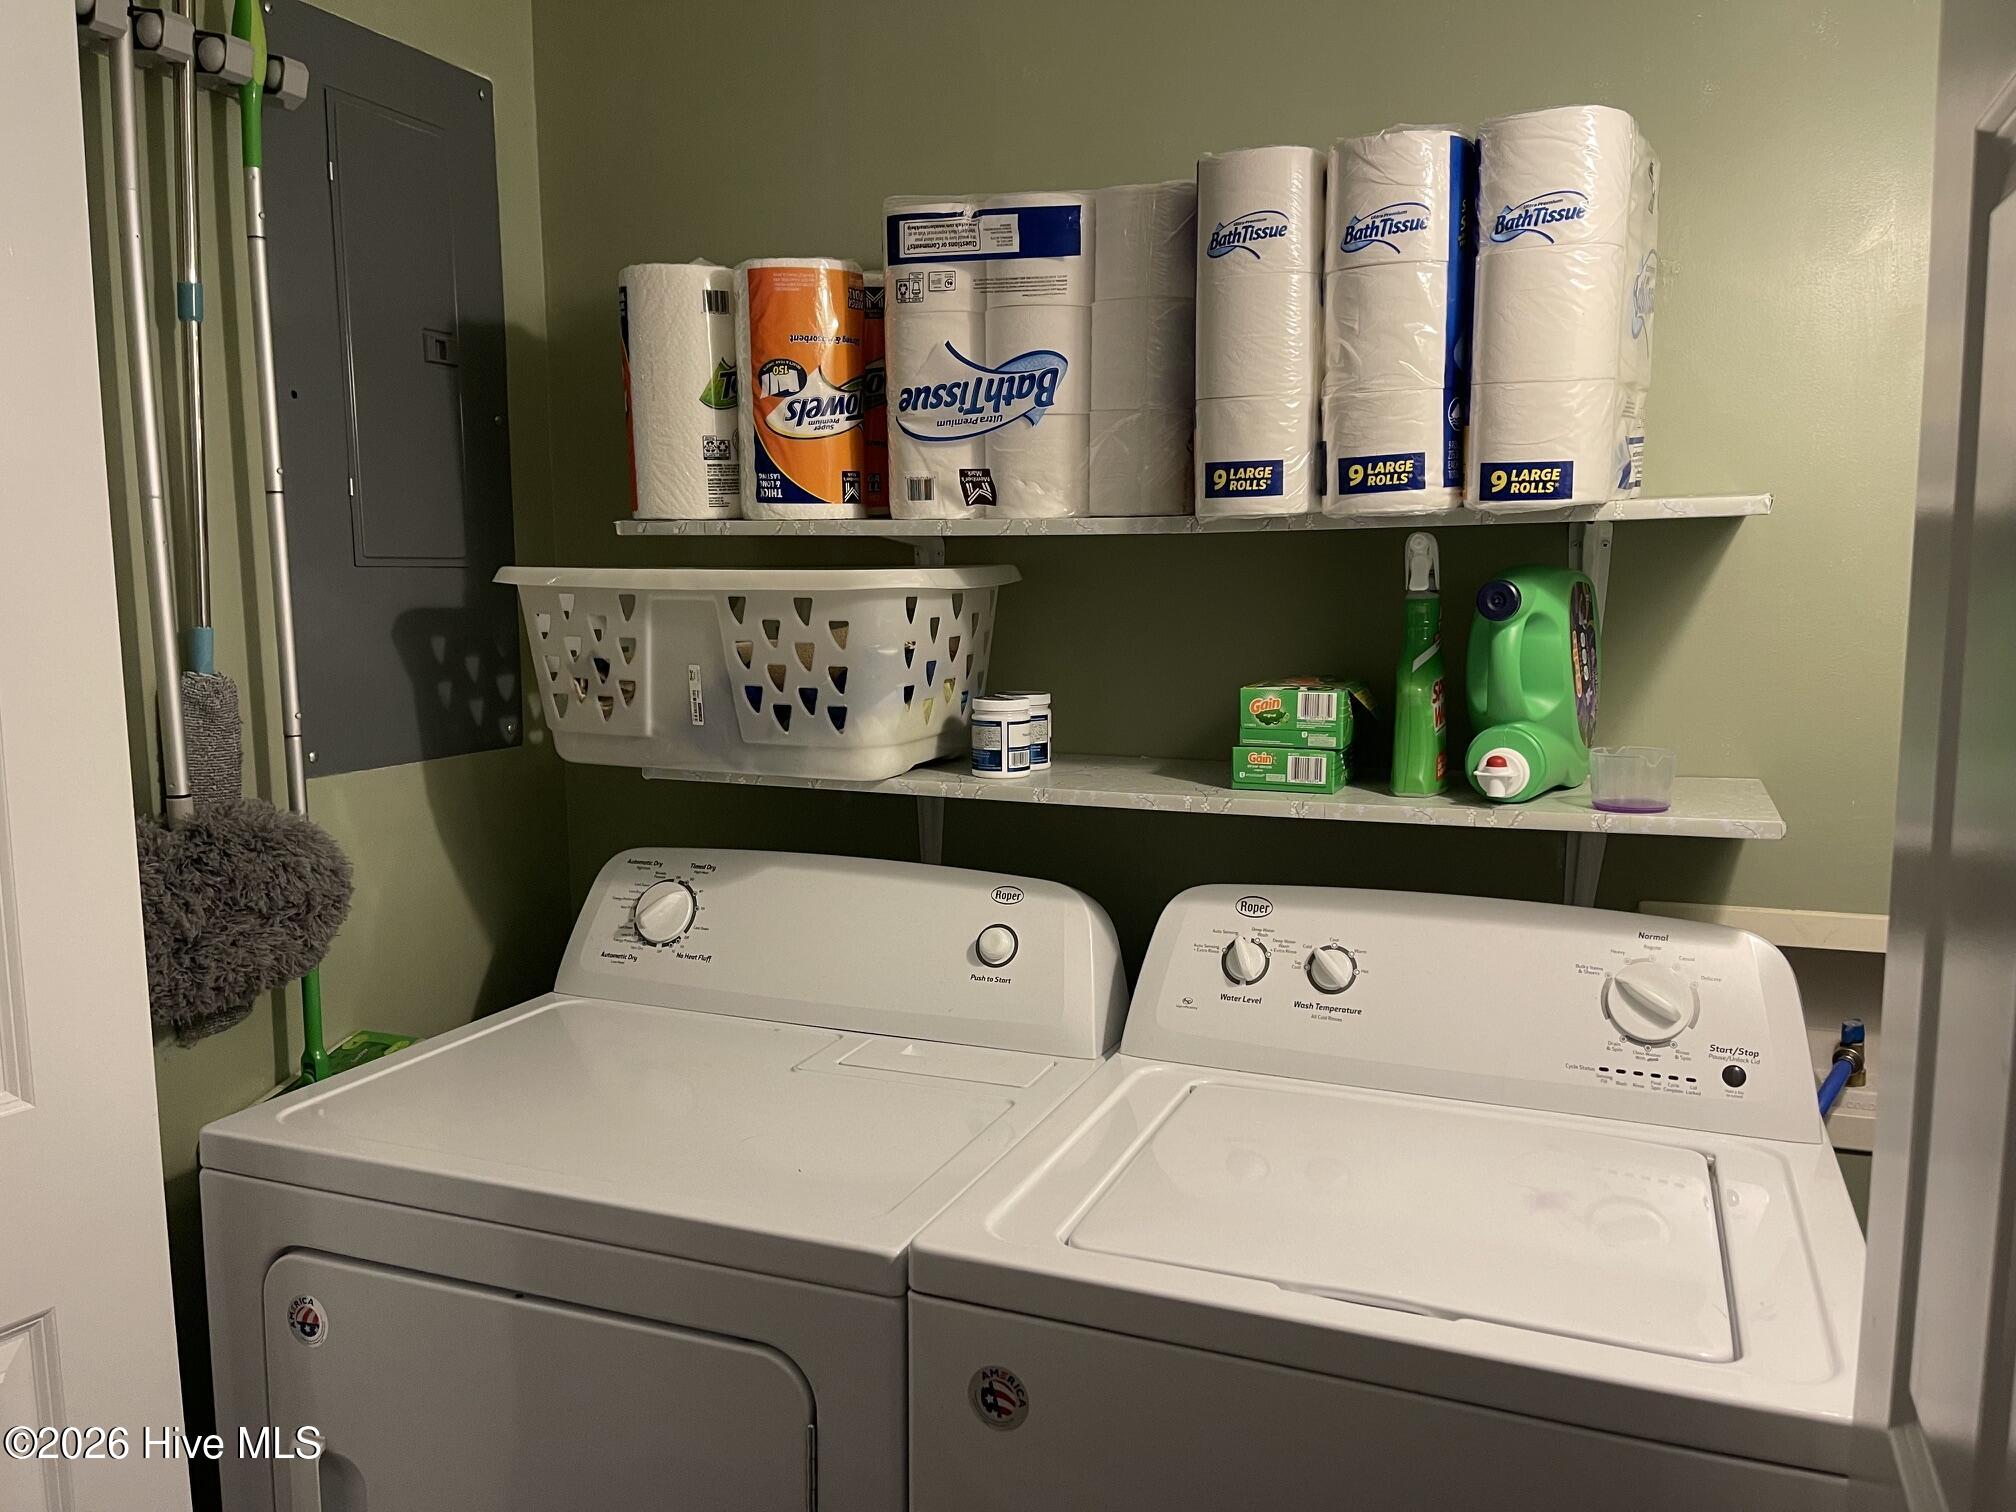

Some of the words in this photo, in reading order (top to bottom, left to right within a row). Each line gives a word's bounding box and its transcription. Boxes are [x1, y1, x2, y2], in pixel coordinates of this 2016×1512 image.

[907, 242, 940, 251] Comments?
[948, 240, 977, 248] Questions
[773, 366, 789, 375] 150
[785, 393, 864, 427] Towels
[808, 418, 840, 426] Premium
[937, 417, 979, 428] Premium
[980, 415, 1003, 423] Ultra
[1213, 469, 1227, 491] 9
[1229, 466, 1273, 479] LARGE
[1348, 464, 1364, 486] 9
[1367, 460, 1414, 474] LARGE
[1491, 470, 1508, 493] 9
[1510, 468, 1561, 481] LARGE
[1250, 697, 1281, 714] Gain
[1248, 752, 1273, 764] Gain
[654, 860, 663, 868] Dry
[706, 864, 716, 872] Dry
[995, 890, 1021, 901] Roper
[1240, 901, 1270, 916] Roper
[1638, 932, 1669, 941] Normal
[601, 951, 627, 959] Automatic
[628, 953, 638, 962] Dry
[698, 955, 712, 963] Fluff
[970, 974, 986, 982] Push
[1220, 993, 1242, 1002] Water
[1243, 996, 1262, 1004] Level
[1294, 1001, 1313, 1009] Wash
[1315, 1003, 1362, 1015] Temperature
[1709, 1044, 1759, 1058] Start/Stop
[290, 1297, 314, 1329] AMERICA
[982, 1368, 1026, 1408] AMERICA
